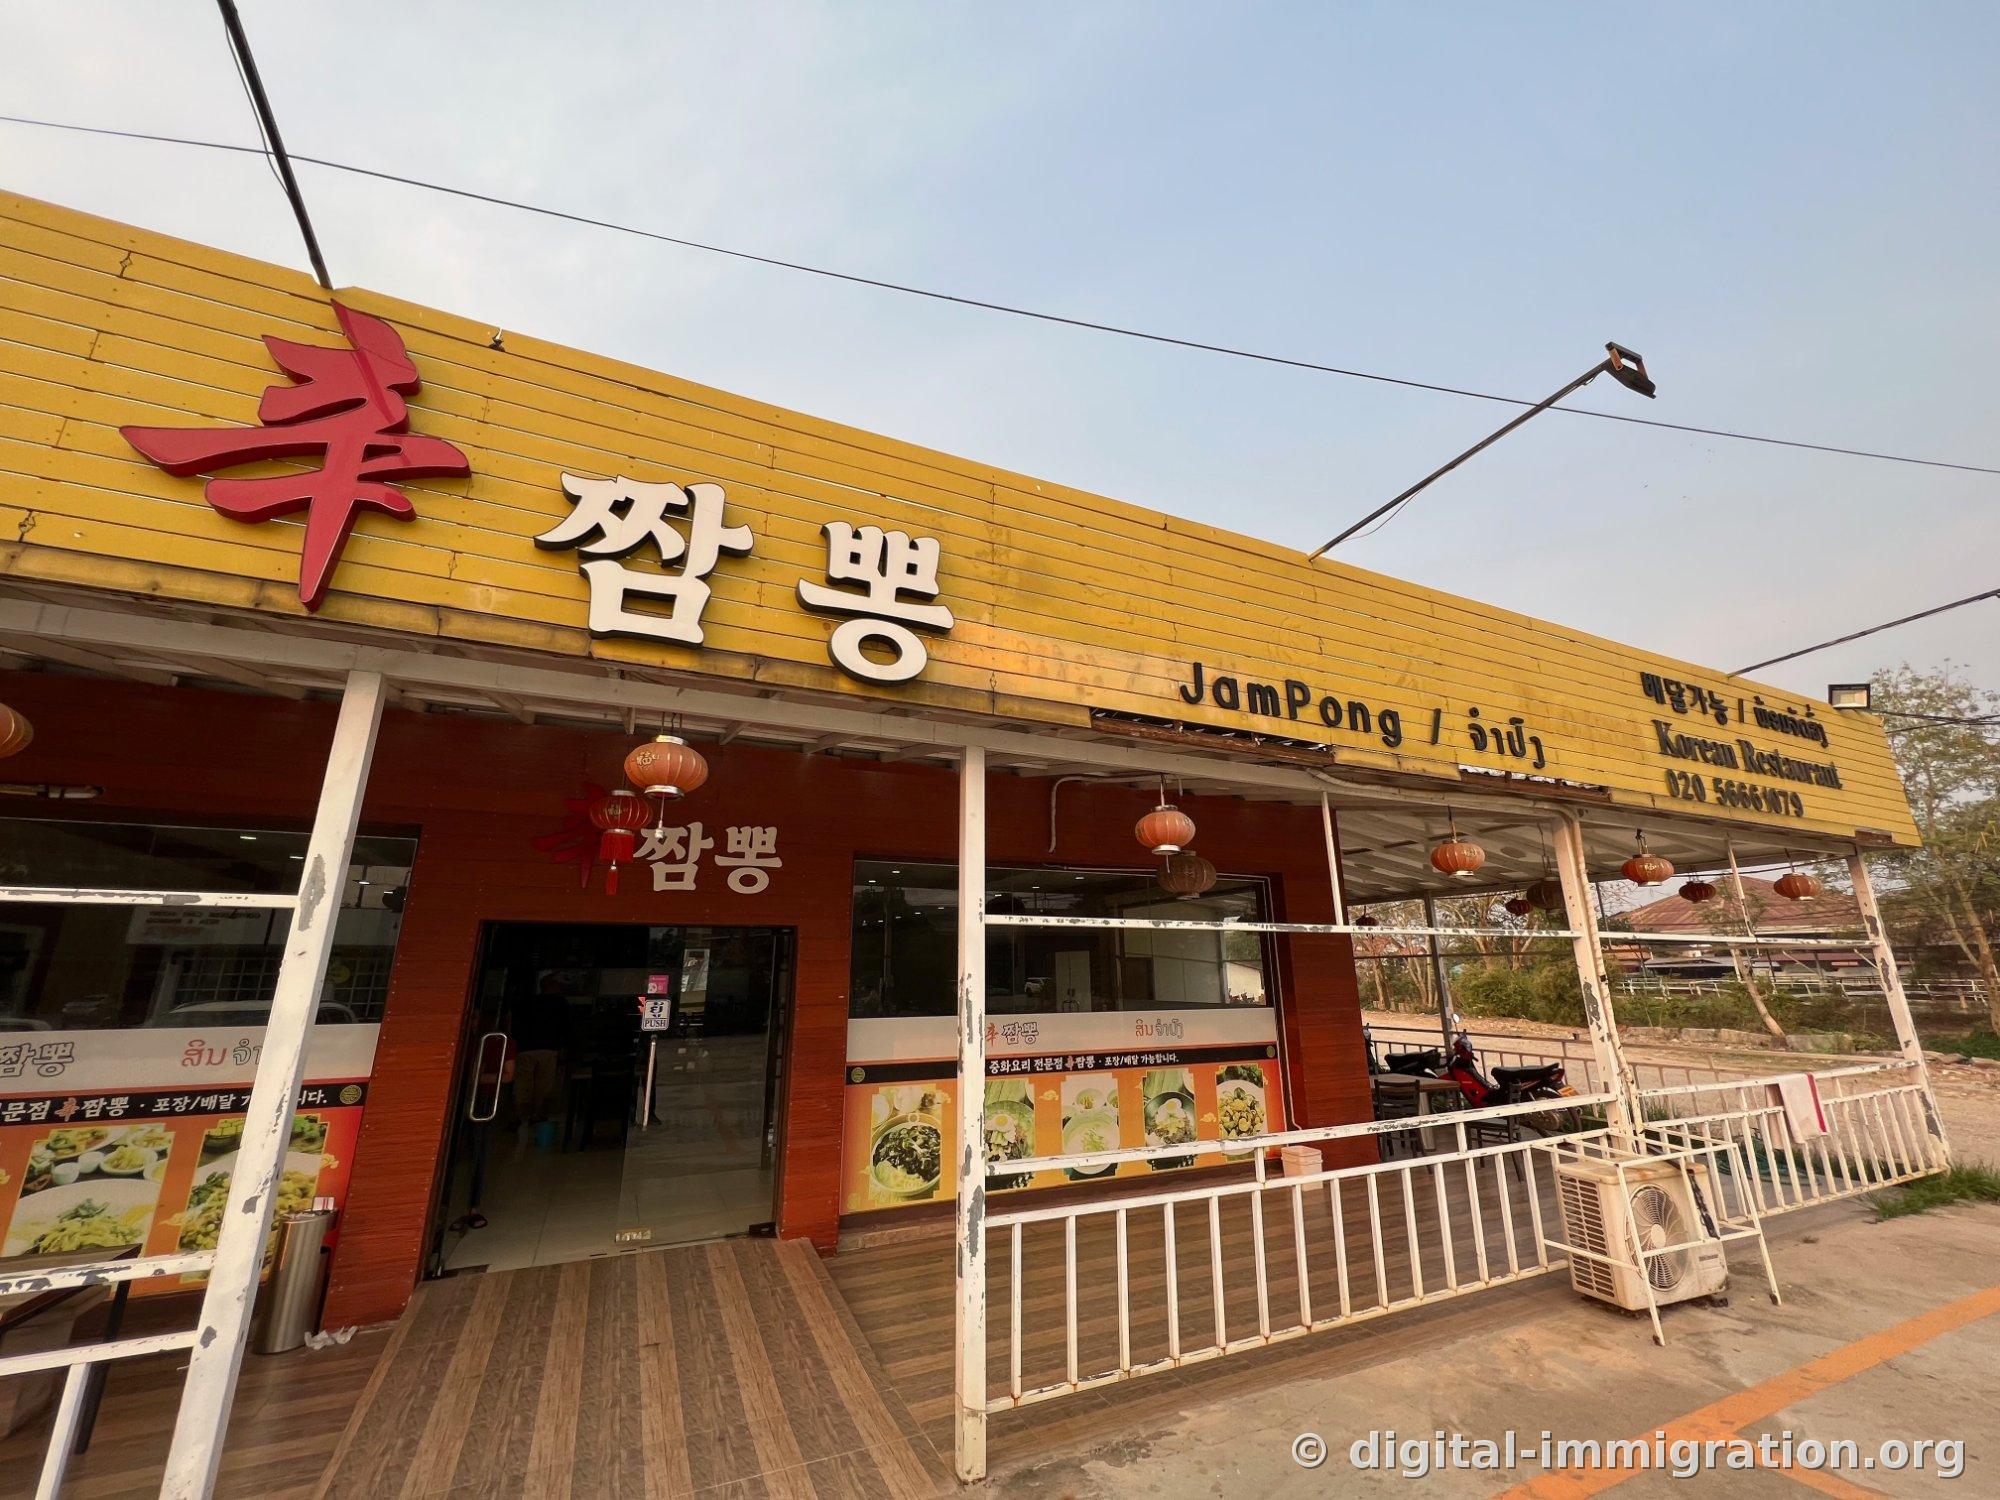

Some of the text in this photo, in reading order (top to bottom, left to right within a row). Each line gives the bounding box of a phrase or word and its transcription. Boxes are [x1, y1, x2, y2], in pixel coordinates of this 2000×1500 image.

[534, 471, 955, 686] 짬뽕
[1180, 661, 1402, 747] JamPong
[1640, 671, 1728, 725] 배달가능
[1651, 719, 1843, 790] Korean Restaurant
[1665, 768, 1804, 818] 020 56661079
[632, 821, 783, 895] 짬뽕
[644, 1019, 667, 1028] PUSH
[1001, 1021, 1040, 1045] 짬뽕
[988, 1058, 1031, 1075] 중화요리
[1033, 1057, 1064, 1071] 전문점
[1075, 1055, 1096, 1069] 짬뽕
[1104, 1054, 1139, 1067] 포장/배달
[1140, 1052, 1180, 1065] 가능합니다.
[0, 1100, 52, 1122] 문점
[81, 1096, 130, 1118] 짬뽕
[152, 1093, 236, 1113] 포장/배달
